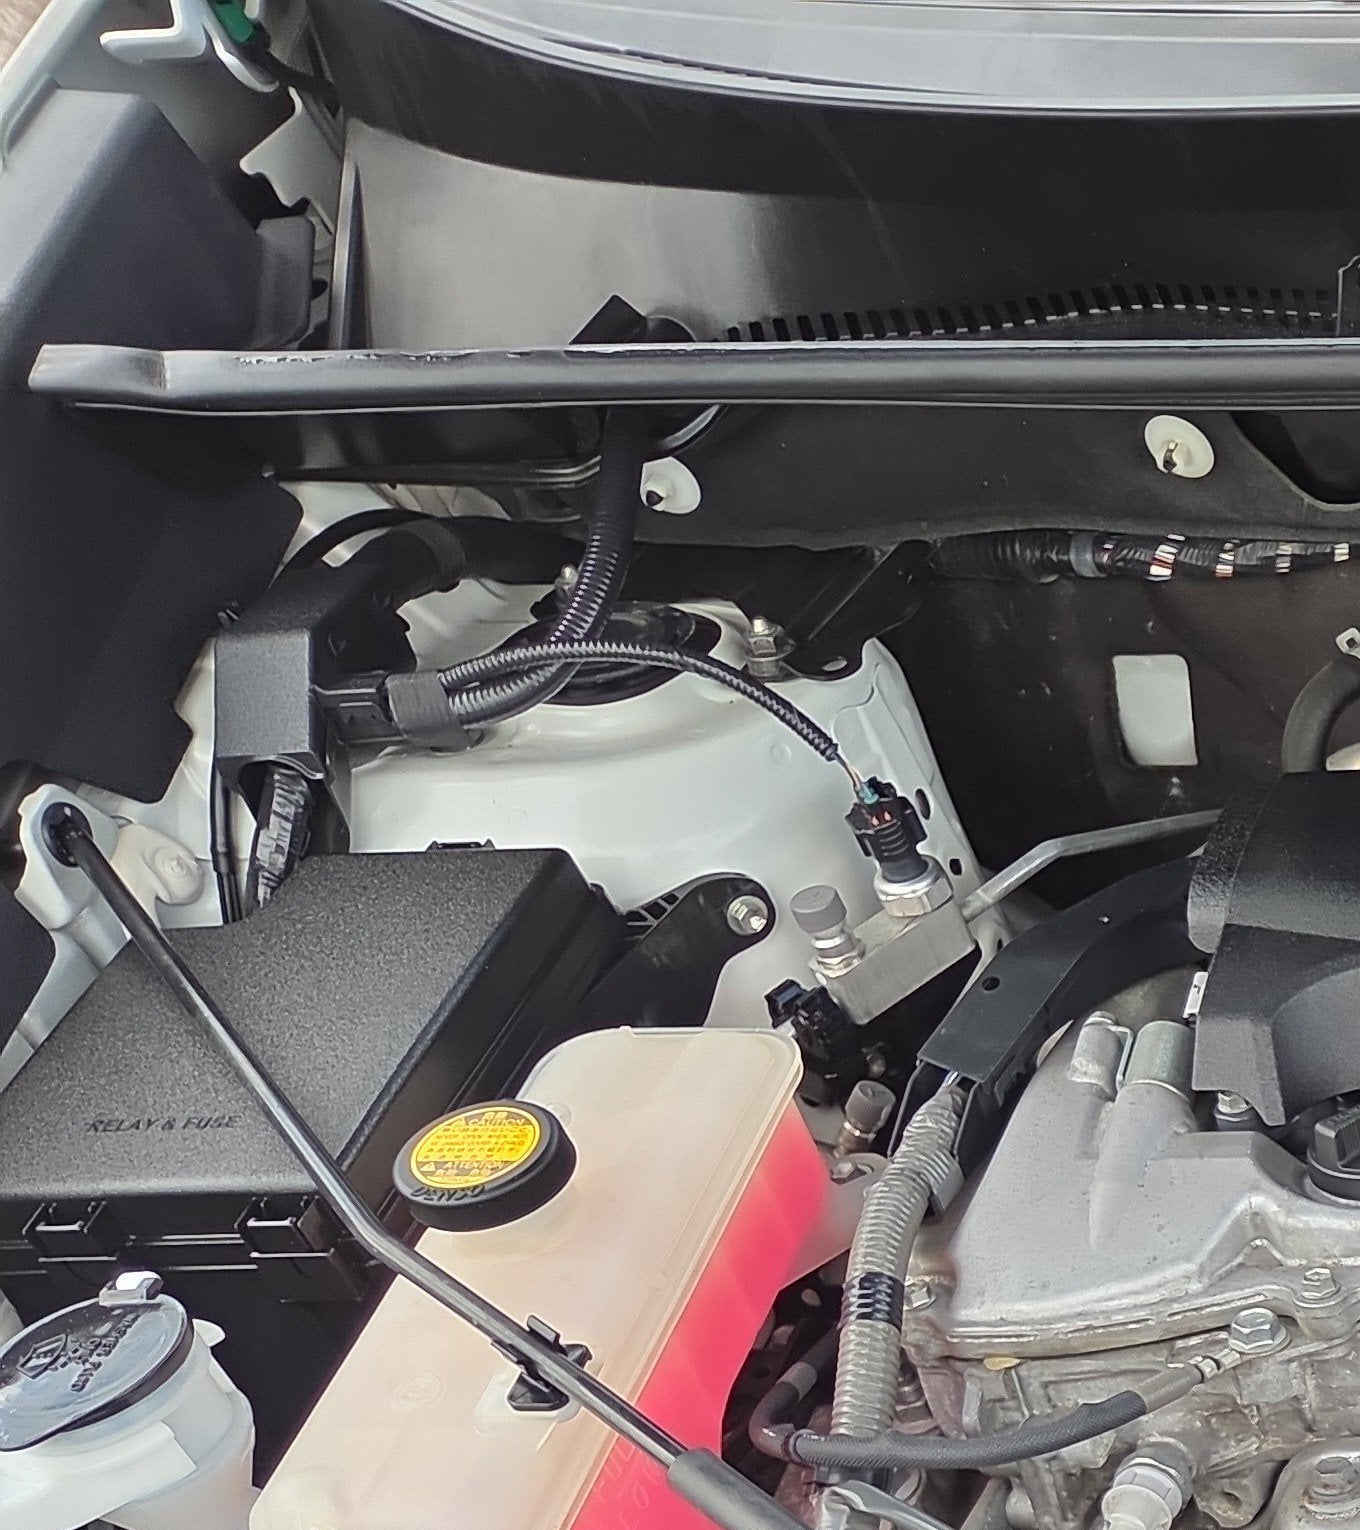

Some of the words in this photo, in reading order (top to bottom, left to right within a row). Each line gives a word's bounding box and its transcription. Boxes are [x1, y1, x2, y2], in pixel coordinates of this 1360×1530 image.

[86, 1118, 160, 1133] RELAY
[161, 1118, 176, 1131] &
[181, 1115, 241, 1130] FUSE
